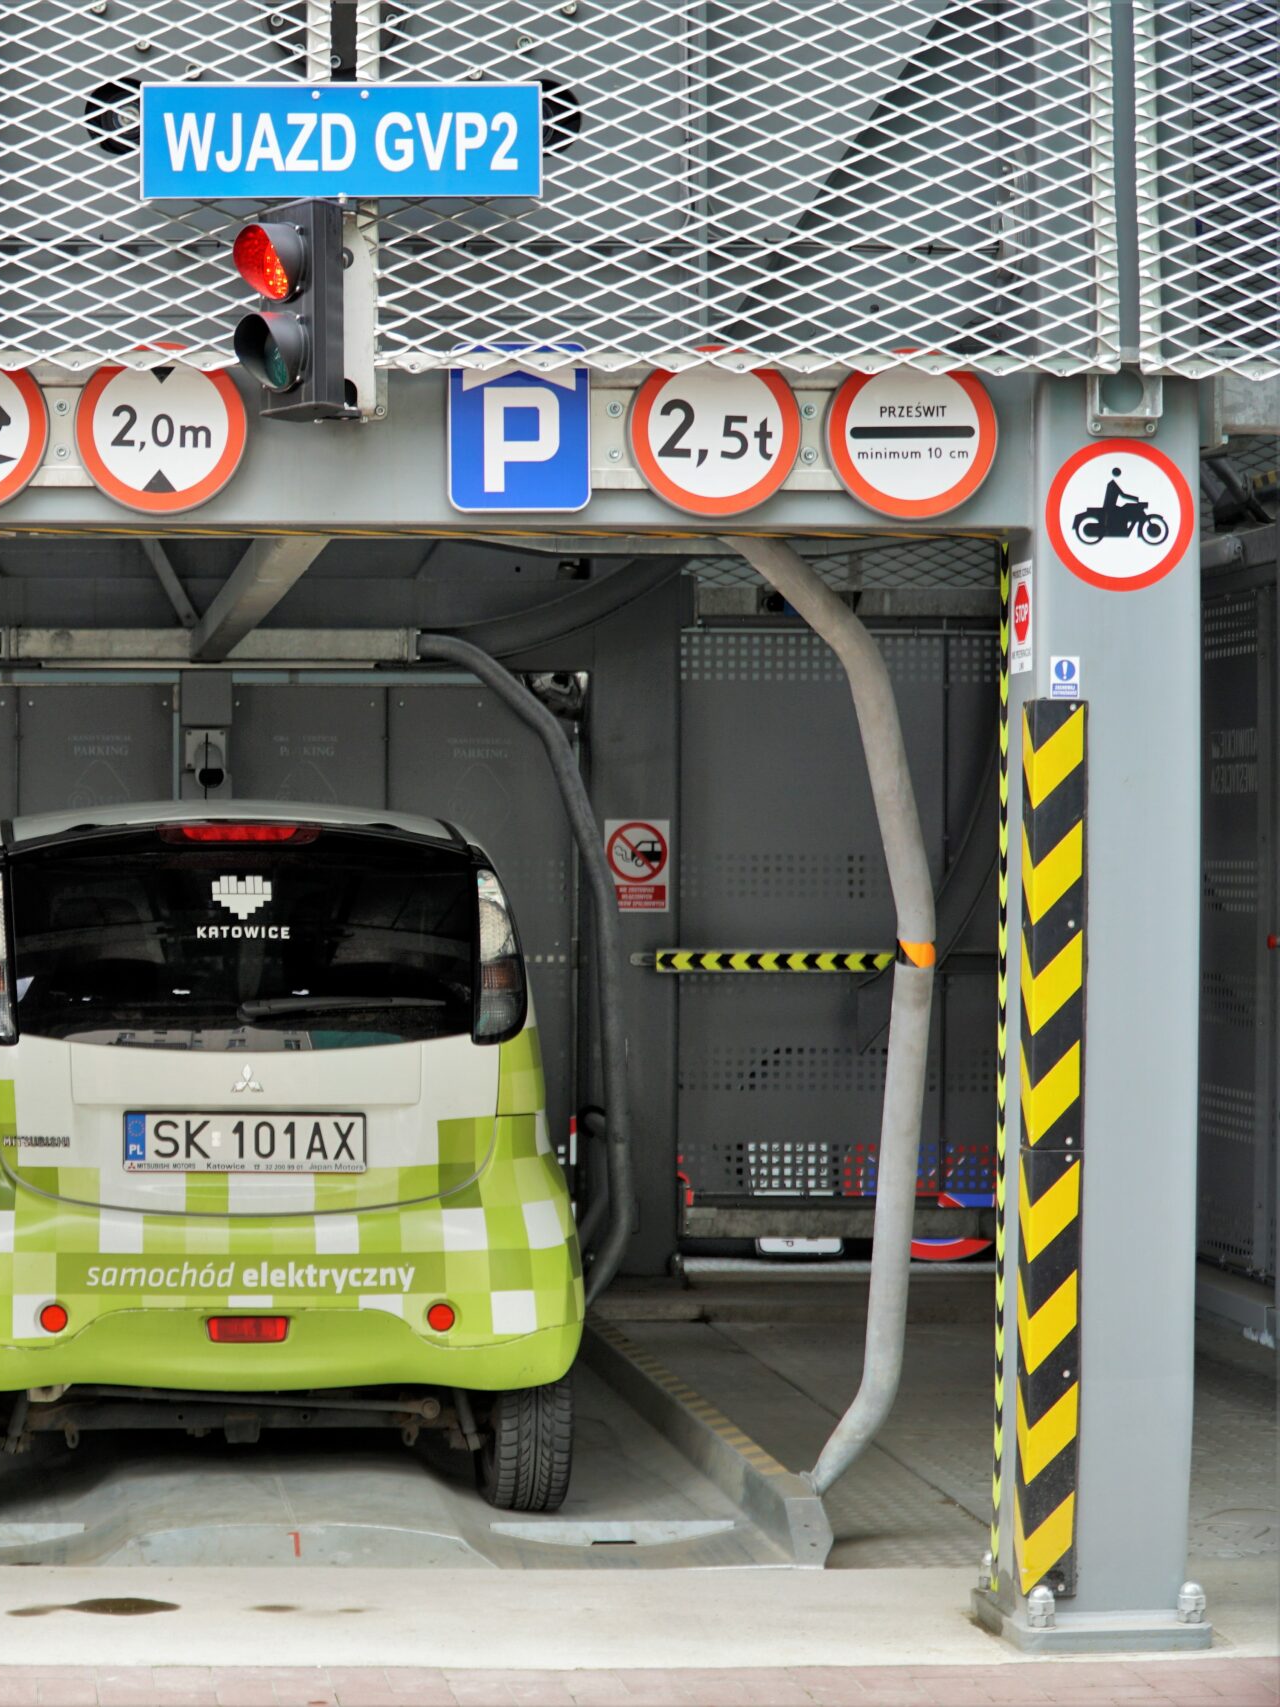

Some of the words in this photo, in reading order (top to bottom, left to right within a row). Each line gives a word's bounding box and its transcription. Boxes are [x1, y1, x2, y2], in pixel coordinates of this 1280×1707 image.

[163, 112, 356, 172] WJAZD
[375, 111, 518, 172] GVP2
[879, 402, 948, 418] PRZEŚWIT
[110, 404, 212, 451] 2,0m
[483, 386, 560, 493] P
[658, 398, 773, 468] 2,5t
[857, 447, 921, 460] minimum
[927, 446, 942, 460] 10
[949, 449, 969, 460] cm
[1015, 603, 1029, 624] STOP
[196, 926, 290, 940] KATOWICE
[128, 1144, 144, 1155] PL
[153, 1120, 211, 1159] SK
[231, 1120, 356, 1160] 101AX
[136, 1162, 170, 1170] MITSUBISHI
[172, 1162, 196, 1170] MOTORS
[206, 1162, 245, 1170] Katowice
[309, 1163, 333, 1171] Japan
[335, 1163, 364, 1171] Motors
[86, 1261, 236, 1288] samochód
[242, 1261, 416, 1294] elektryczny
